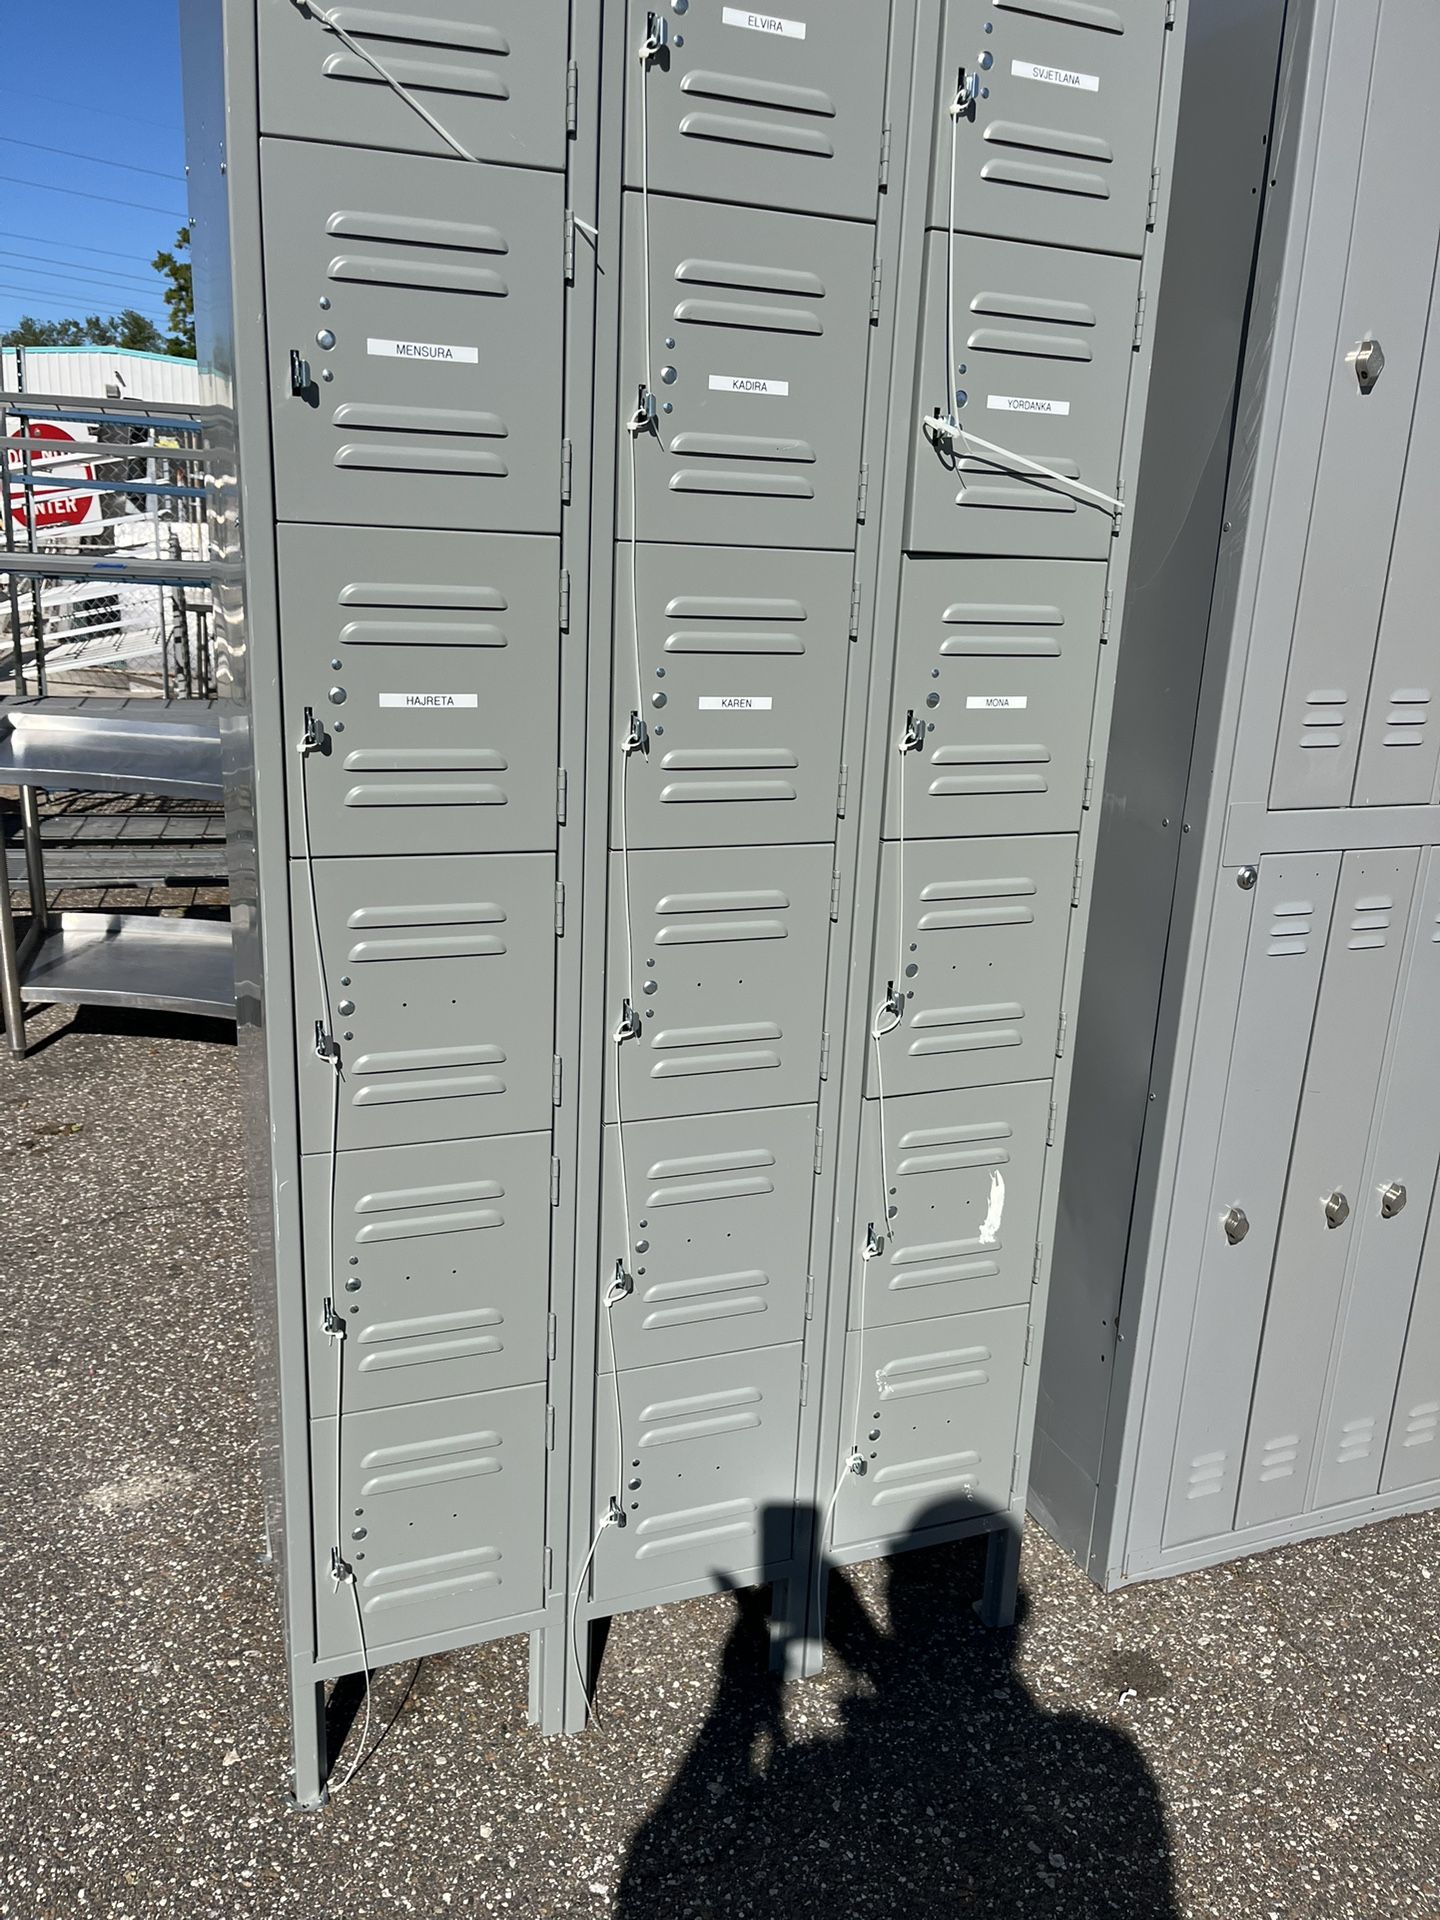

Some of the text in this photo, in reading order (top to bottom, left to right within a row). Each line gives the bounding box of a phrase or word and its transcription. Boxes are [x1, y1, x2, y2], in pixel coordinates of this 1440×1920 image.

[747, 15, 783, 32] ELVIRA
[1033, 67, 1080, 85] SVJETLANA
[396, 344, 453, 359] MENSURA
[732, 380, 768, 392] KADIRA
[1007, 399, 1052, 411] YORDANKA
[406, 695, 455, 706] HAJRETA
[721, 698, 752, 708] KAREN
[985, 698, 1009, 707] MONA
